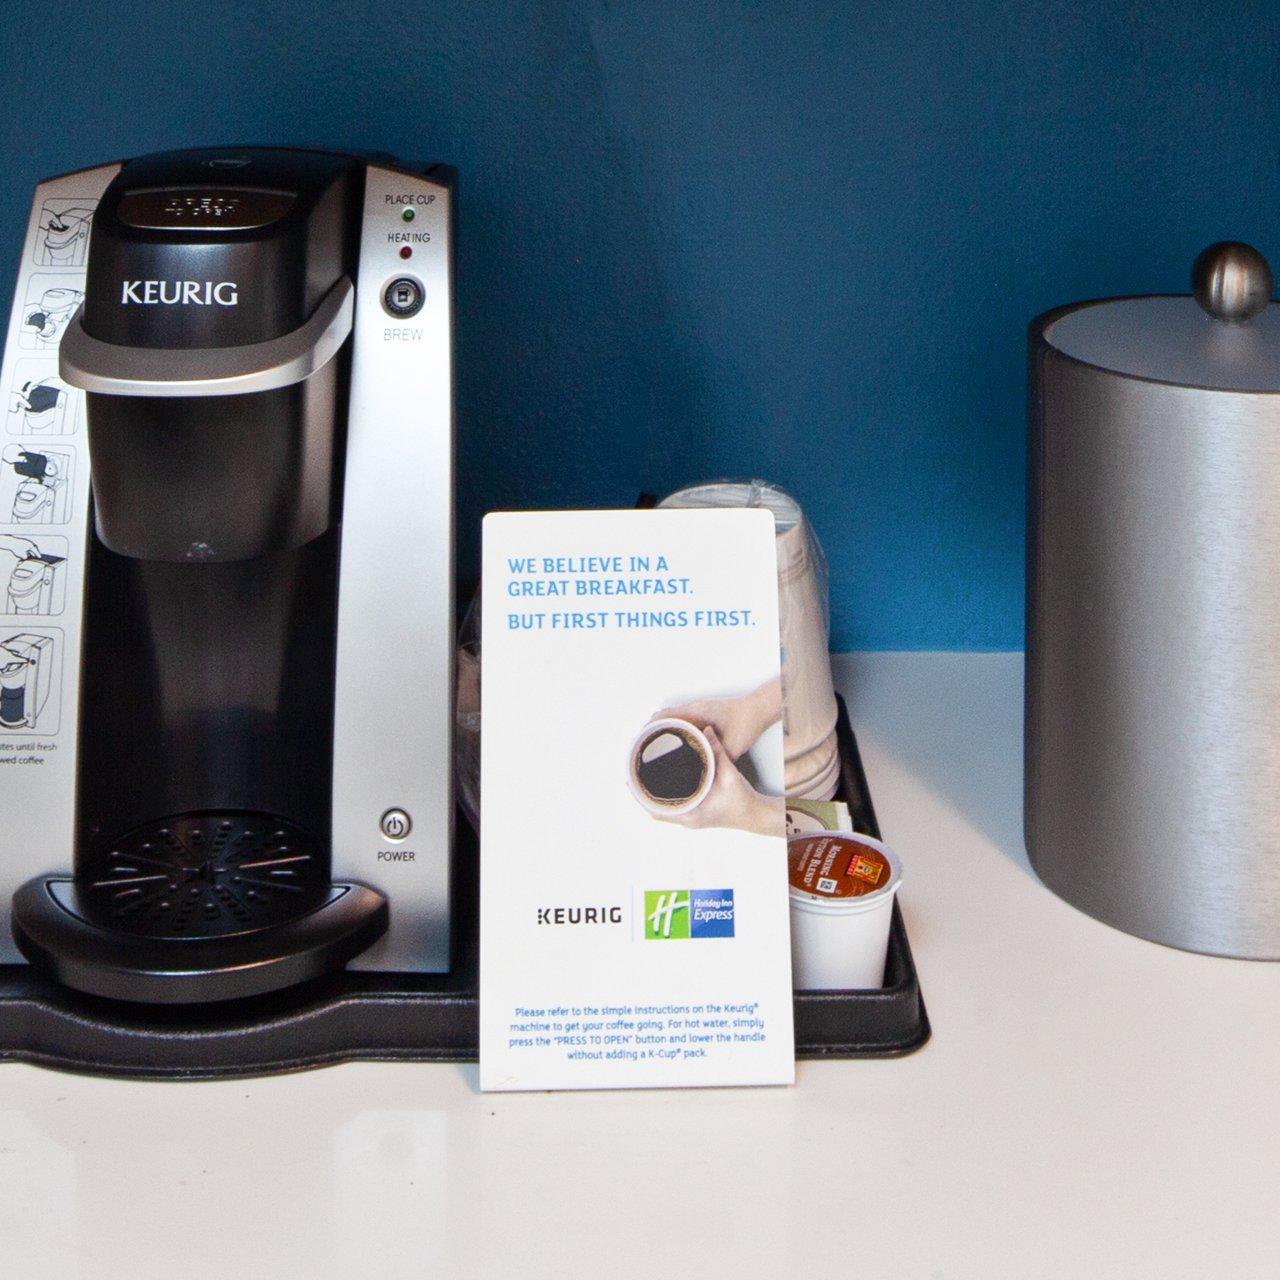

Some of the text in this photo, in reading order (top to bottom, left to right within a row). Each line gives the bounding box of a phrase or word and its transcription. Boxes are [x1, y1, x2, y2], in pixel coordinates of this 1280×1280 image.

[385, 194, 437, 205] PLACE CUP
[387, 233, 431, 244] HEATING
[121, 280, 238, 306] KEURIG
[383, 328, 424, 341] BREW
[507, 556, 669, 574] WE BELIEVE IN A
[507, 578, 694, 597] GREAT BREAKFAST.
[507, 610, 756, 630] BUT FIRST THINGS FIRST.
[16, 742, 36, 751] until
[36, 742, 58, 752] fresh
[19, 756, 45, 765] coffee
[377, 851, 416, 862] POWER
[537, 907, 623, 925] KEURIG
[694, 908, 733, 923] Express
[515, 1007, 545, 1017] Please
[548, 1007, 569, 1016] refer
[571, 1007, 581, 1016] to
[583, 1006, 599, 1016] the
[601, 1006, 632, 1017] simple
[634, 1005, 690, 1015] instructions
[692, 1006, 704, 1014] on
[706, 1004, 721, 1013] the
[510, 1022, 551, 1032] machine
[553, 1022, 561, 1031] to
[565, 1022, 580, 1033] get
[582, 1022, 603, 1033] your
[605, 1020, 634, 1030] coffee
[637, 1020, 665, 1031] going.
[668, 1019, 682, 1029] For
[685, 1019, 701, 1028] hot
[733, 1018, 765, 1029] simply
[509, 1038, 533, 1048] press
[535, 1037, 551, 1046] the
[590, 1035, 601, 1045] TO
[635, 1034, 666, 1044] button
[669, 1034, 687, 1043] and
[689, 1033, 714, 1043] lower
[716, 1032, 731, 1042] the
[734, 1032, 766, 1042] handle
[567, 1050, 603, 1060] without
[605, 1049, 638, 1061] adding
[684, 1048, 707, 1059] pack.
